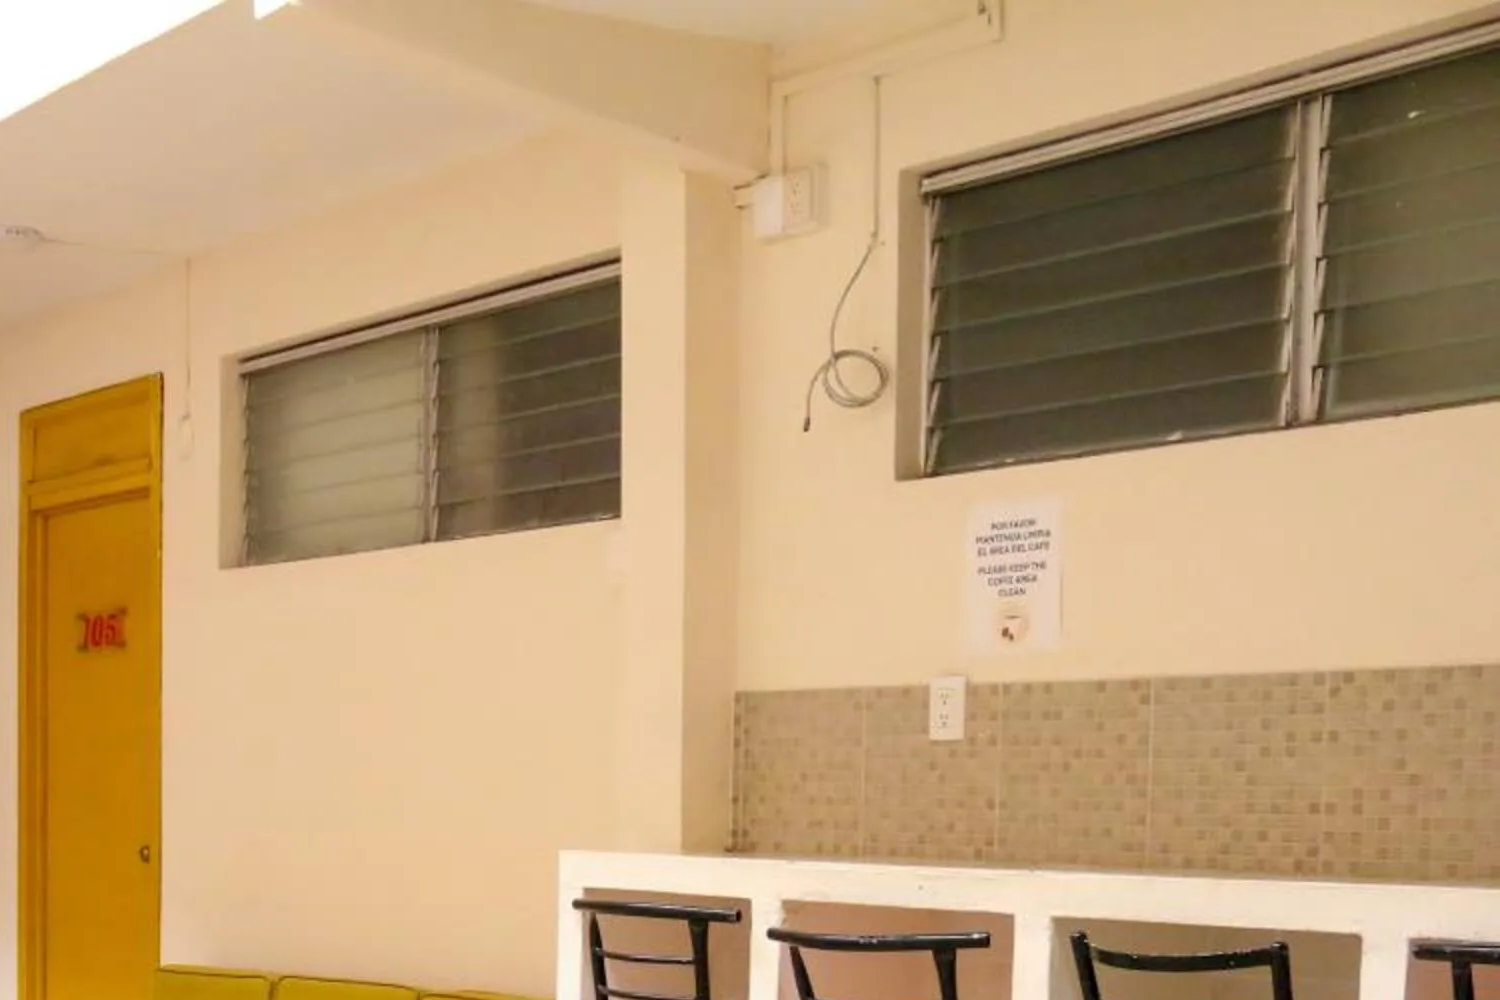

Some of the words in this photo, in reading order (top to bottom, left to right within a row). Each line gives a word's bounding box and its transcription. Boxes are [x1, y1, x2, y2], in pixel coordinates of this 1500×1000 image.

[977, 547, 988, 557] EL
[1011, 543, 1027, 553] DEL
[1030, 560, 1047, 571] THE
[997, 586, 1027, 597] CLEAN
[80, 613, 120, 649] 105
